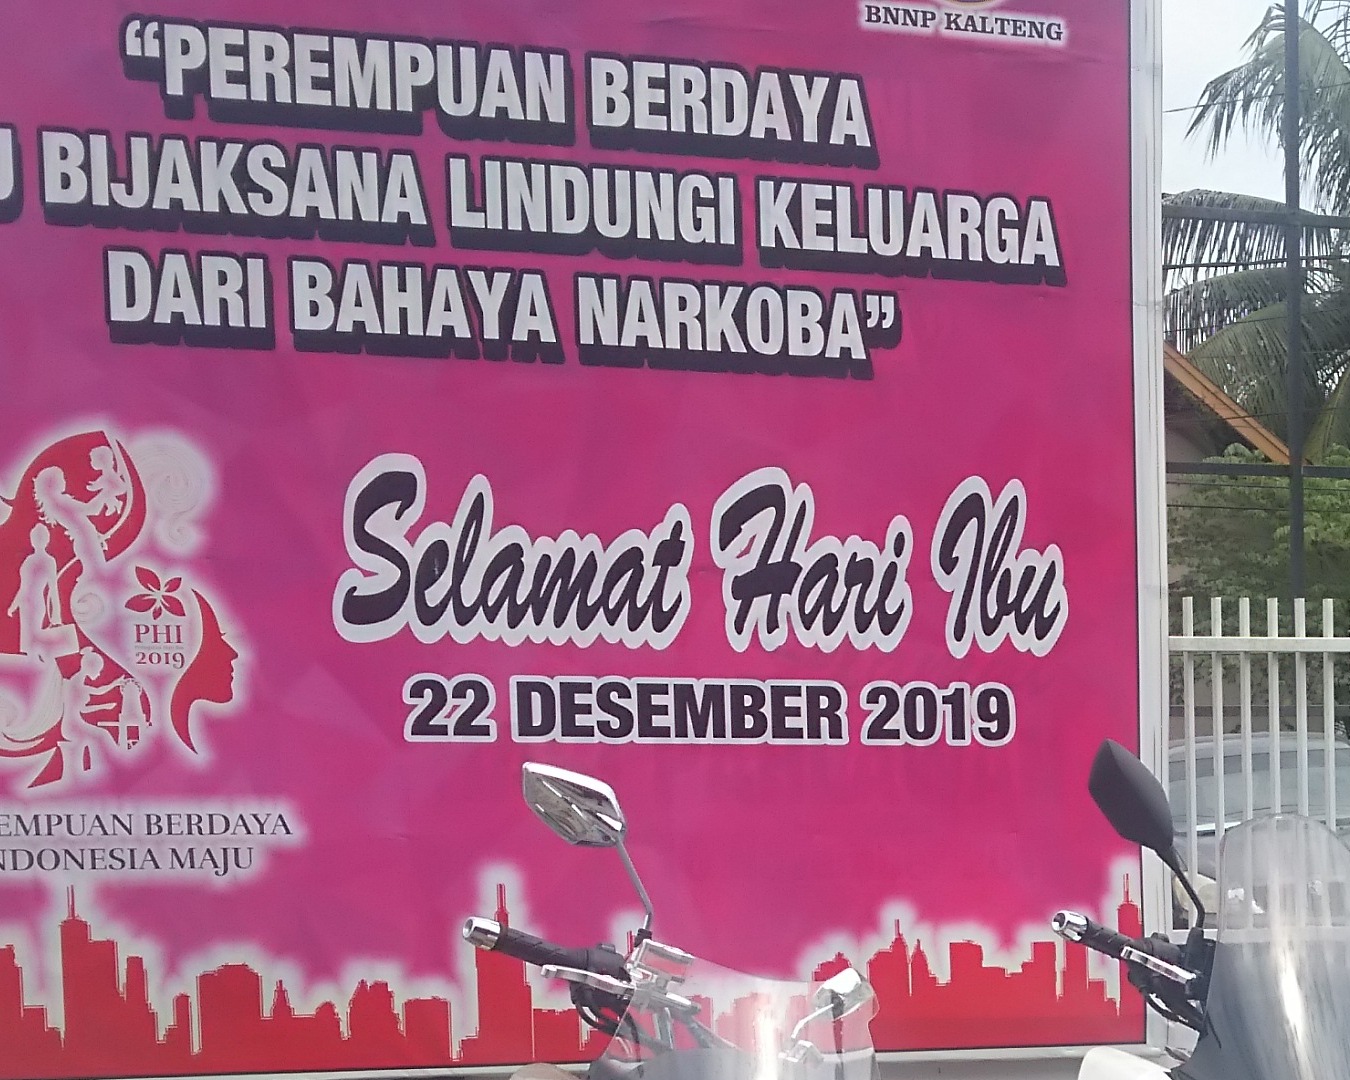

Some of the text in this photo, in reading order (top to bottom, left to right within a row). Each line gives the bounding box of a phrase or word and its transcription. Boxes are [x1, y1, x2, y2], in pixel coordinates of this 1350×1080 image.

[864, 4, 1064, 41] BNNP KALTENG
[125, 19, 872, 148] “PEREMPUAN BERDAYA
[42, 130, 428, 226] BIJAKSANA
[449, 157, 736, 246] LINDUNGI
[758, 180, 1061, 267] KELUARGA
[107, 249, 896, 360] DARI BAHAYA NARKOBA”
[338, 465, 1064, 647] Selamat Hari Ibu
[134, 623, 184, 644] PHI
[135, 651, 185, 670] 2019
[408, 678, 1012, 741] 22 DESEMBER 2019
[0, 812, 294, 837] EMPUAN BERDAYA
[0, 846, 254, 877] DONESIA MAJU
